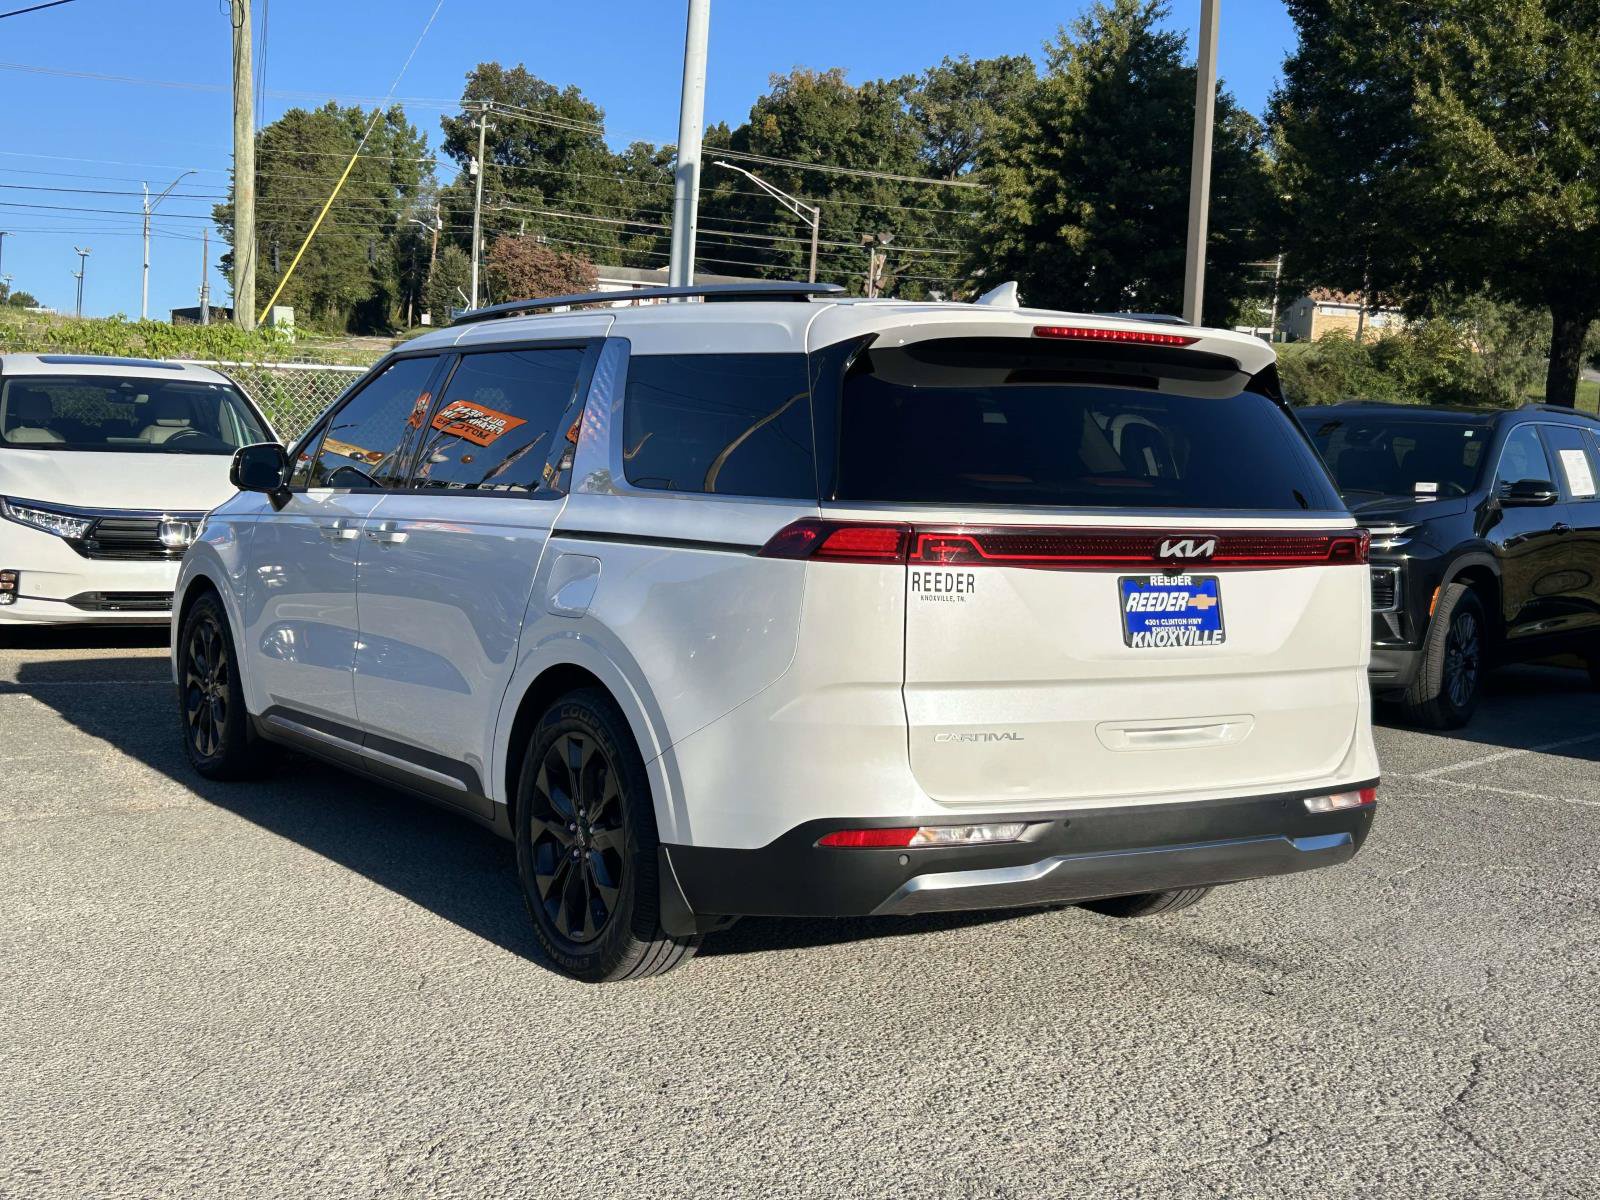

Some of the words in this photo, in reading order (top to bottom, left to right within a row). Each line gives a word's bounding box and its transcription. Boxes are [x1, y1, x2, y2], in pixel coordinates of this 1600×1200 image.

[1160, 539, 1216, 558] KIA
[911, 571, 975, 594] REEDER
[1150, 575, 1192, 586] REEDER
[1125, 592, 1190, 612] REEDER
[1160, 618, 1187, 626] CLINTON
[1187, 617, 1202, 625] HWY
[1131, 630, 1223, 648] KNOXVILLE
[934, 732, 1025, 743] CARNIVAL
